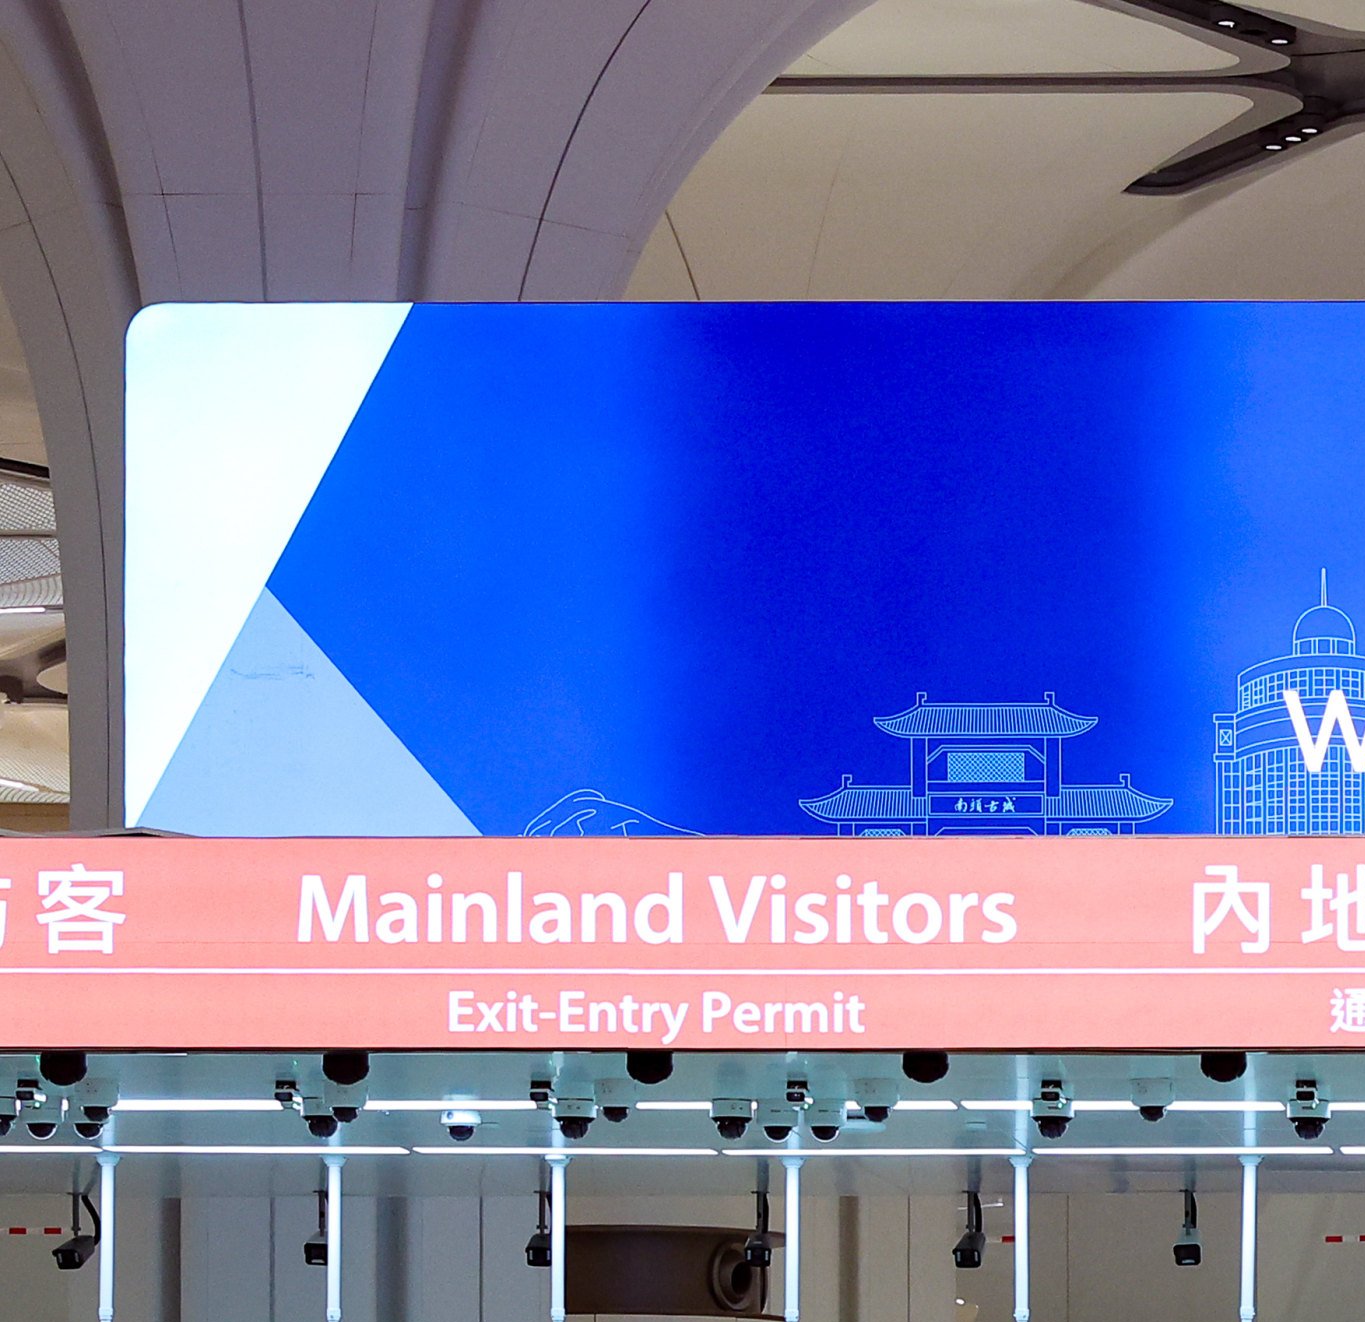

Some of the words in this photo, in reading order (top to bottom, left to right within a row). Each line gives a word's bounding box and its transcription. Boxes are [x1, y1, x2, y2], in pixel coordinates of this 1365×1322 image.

[0, 863, 127, 955] 客
[297, 870, 684, 945] Mainland
[707, 873, 1019, 945] Visitors
[447, 990, 689, 1046] Exit-Entry
[701, 990, 867, 1034] Permit
